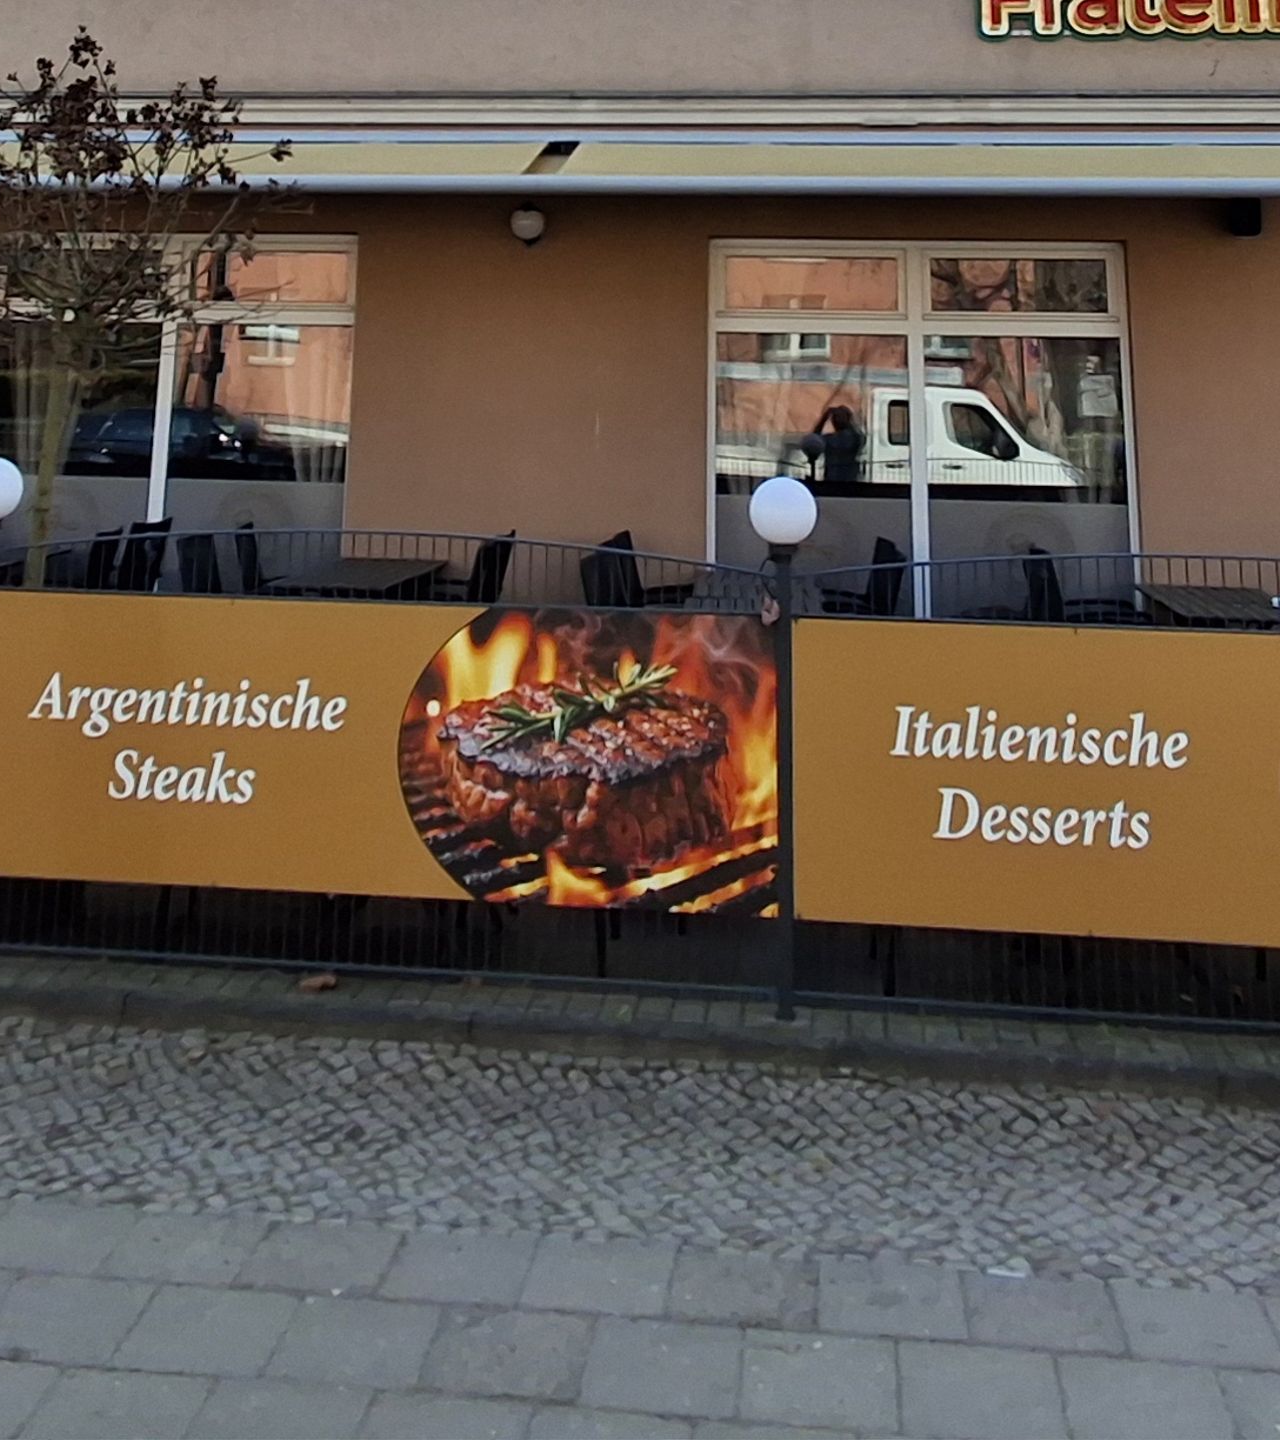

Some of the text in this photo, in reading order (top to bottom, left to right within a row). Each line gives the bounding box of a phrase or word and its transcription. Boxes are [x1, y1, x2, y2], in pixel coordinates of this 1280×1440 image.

[26, 670, 349, 739] Argentinische
[888, 703, 1190, 771] Italienische
[107, 748, 257, 806] Steaks
[931, 785, 1151, 851] Desserts
